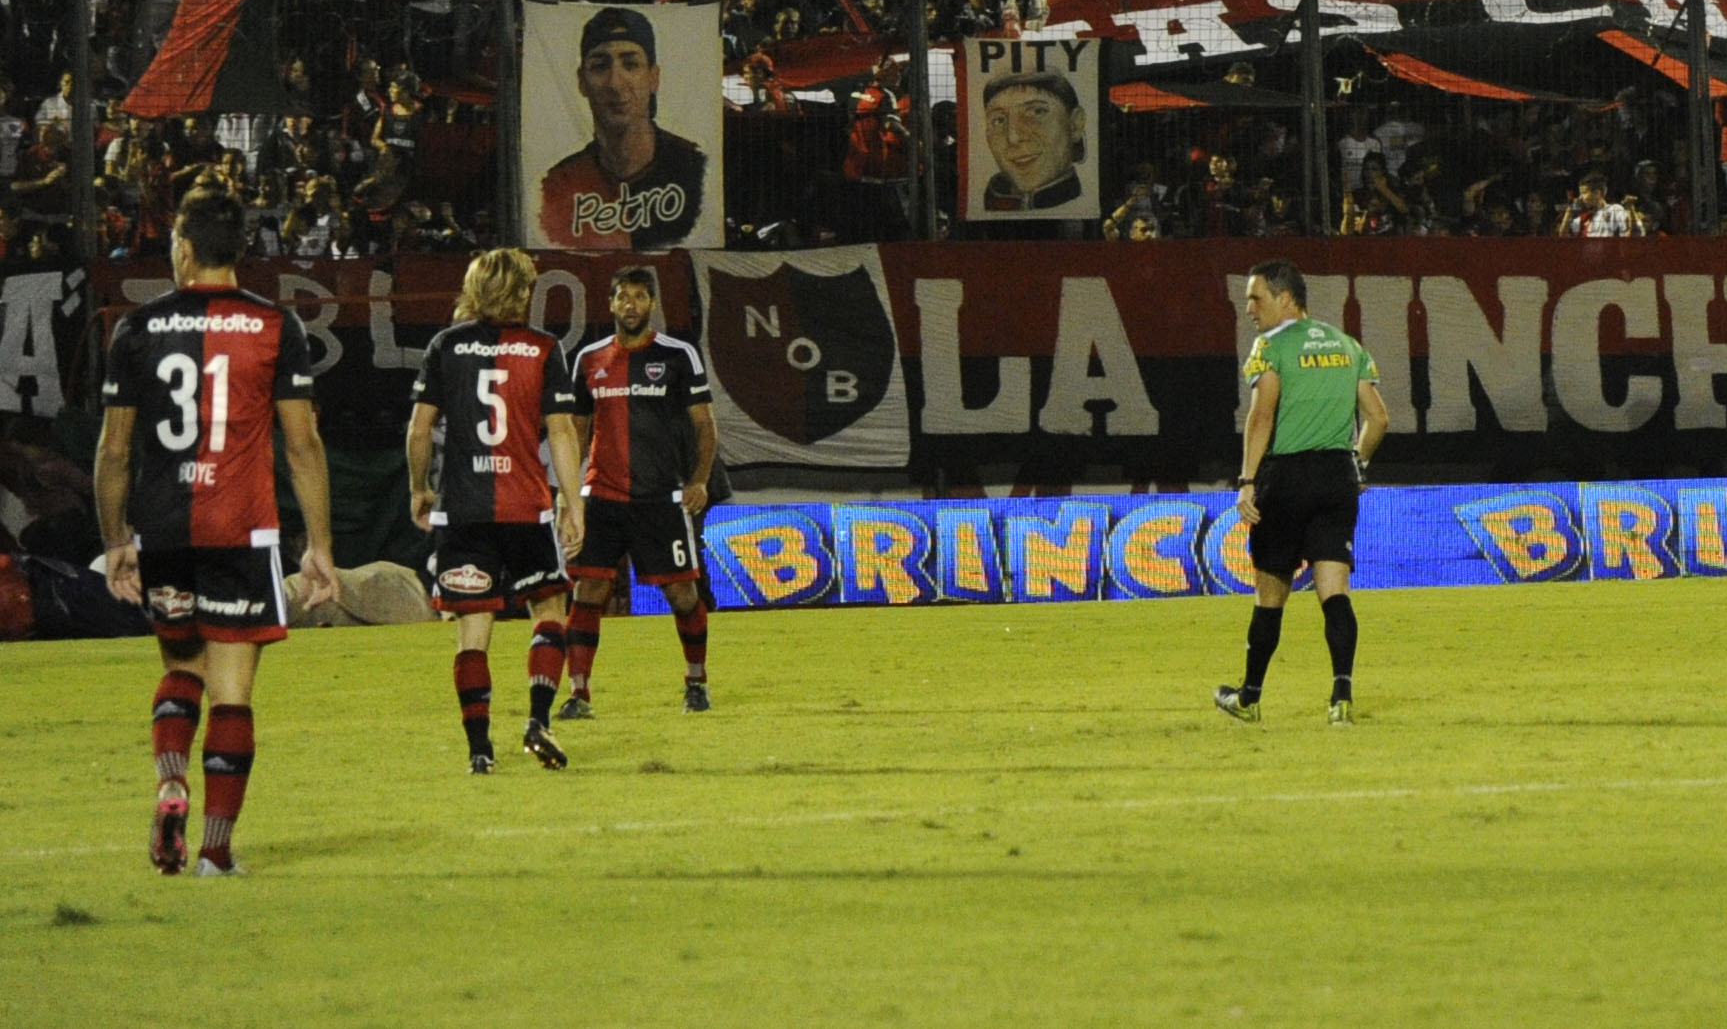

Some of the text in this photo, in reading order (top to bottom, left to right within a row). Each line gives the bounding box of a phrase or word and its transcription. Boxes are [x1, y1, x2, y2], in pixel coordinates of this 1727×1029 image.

[978, 39, 1092, 74] PITY
[572, 182, 686, 236] Petro
[147, 313, 264, 333] autocrédito
[744, 304, 859, 404] N O B
[914, 276, 1160, 437] LA
[156, 352, 230, 453] 31
[477, 368, 509, 446] 5
[473, 455, 511, 474] MATEO
[673, 540, 687, 567] 6
